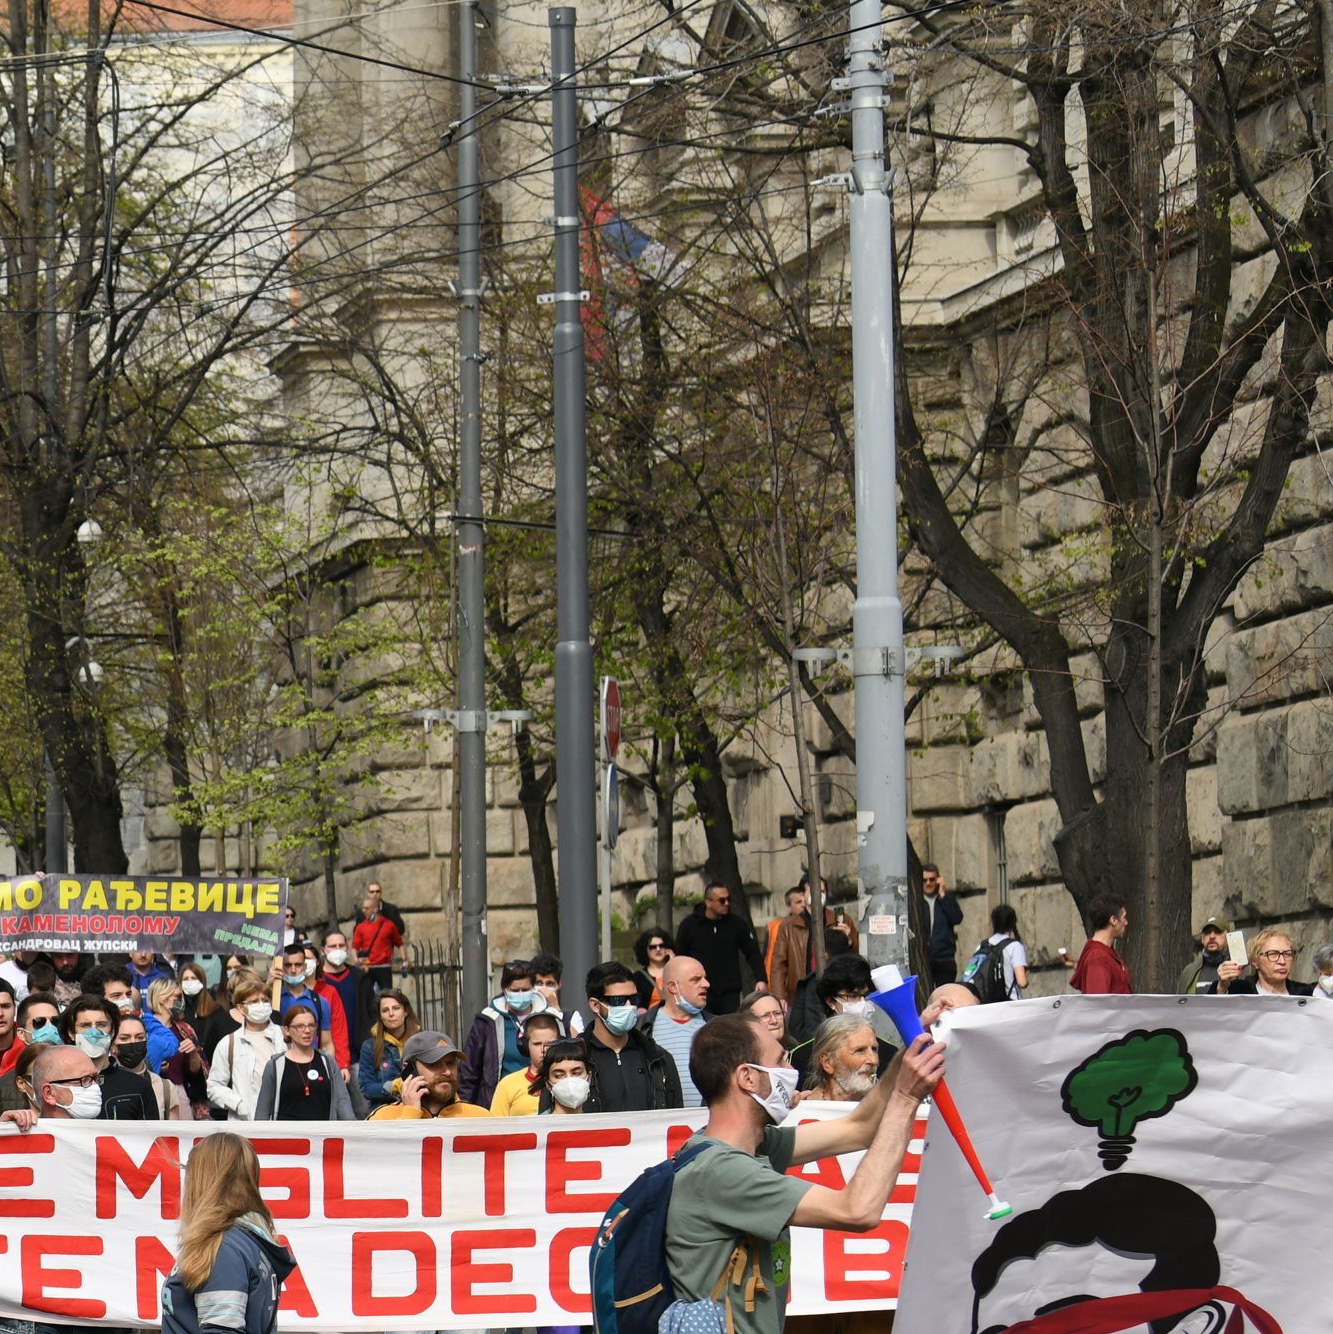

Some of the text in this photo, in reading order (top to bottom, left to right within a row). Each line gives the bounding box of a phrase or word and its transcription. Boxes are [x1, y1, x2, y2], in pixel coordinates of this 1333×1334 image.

[58, 879, 281, 919] РАЂЕВИЦЕ
[1, 914, 181, 936] КАМЕНОЛОМУ
[241, 923, 278, 943] НЕМА
[84, 939, 138, 951] ЖУПСКИ
[214, 928, 276, 957] ПРЕДАЈЕ
